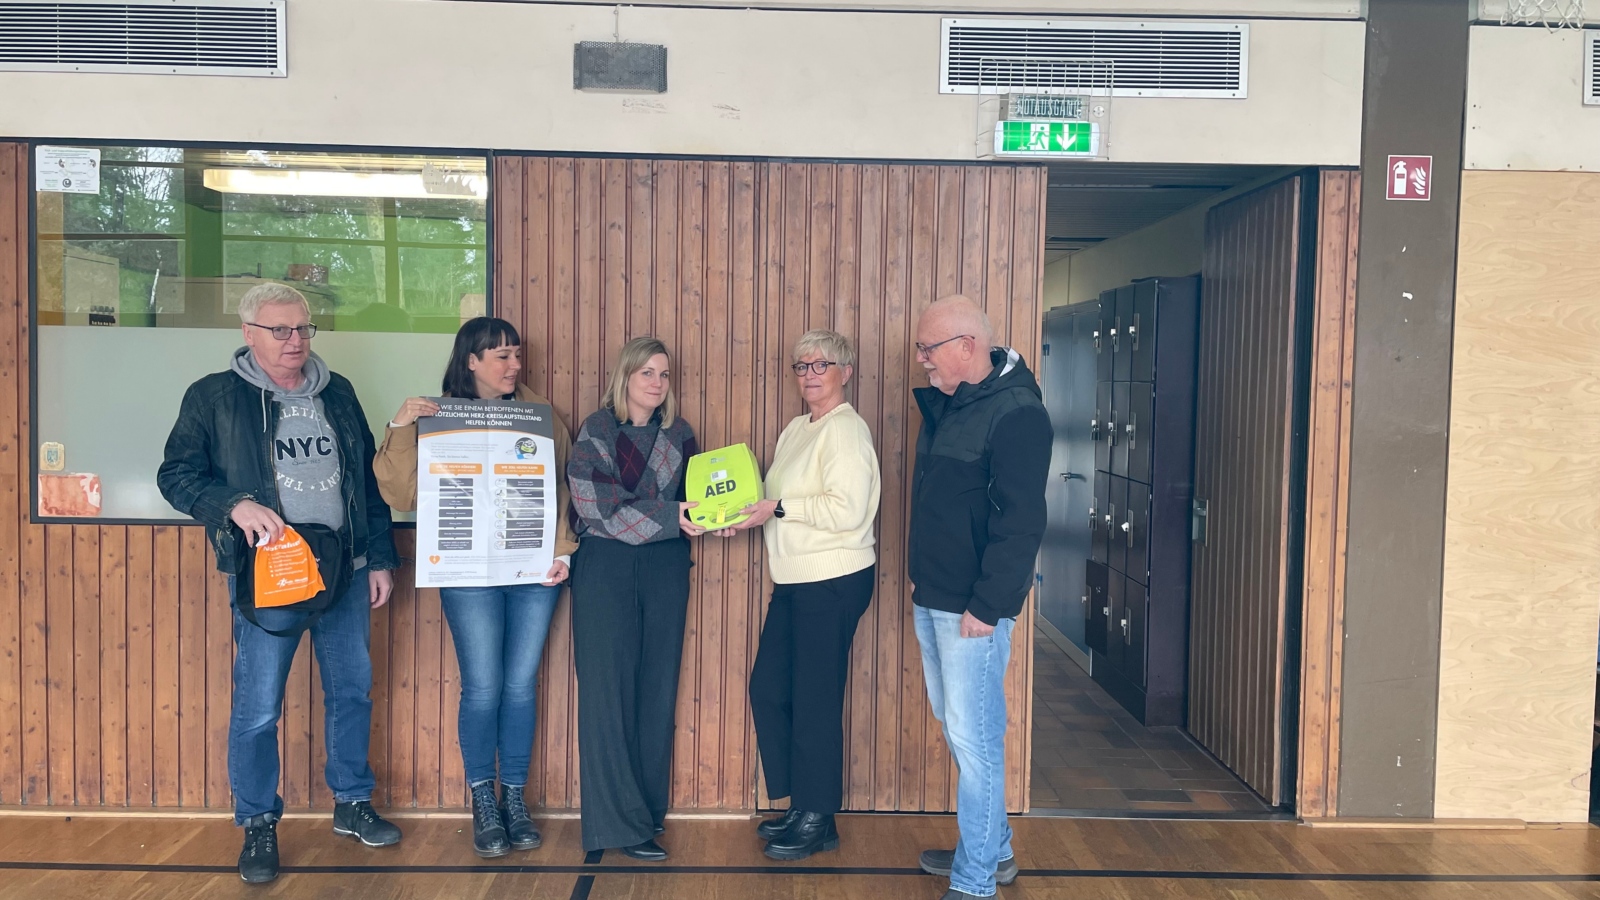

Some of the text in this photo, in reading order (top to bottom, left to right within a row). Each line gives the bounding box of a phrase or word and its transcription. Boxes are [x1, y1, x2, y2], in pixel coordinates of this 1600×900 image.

[470, 412, 542, 422] HERZ-KREISLAUFSTILLSTAND
[486, 419, 513, 427] KÖNNEN
[275, 435, 332, 461] NYC
[705, 479, 737, 499] AED
